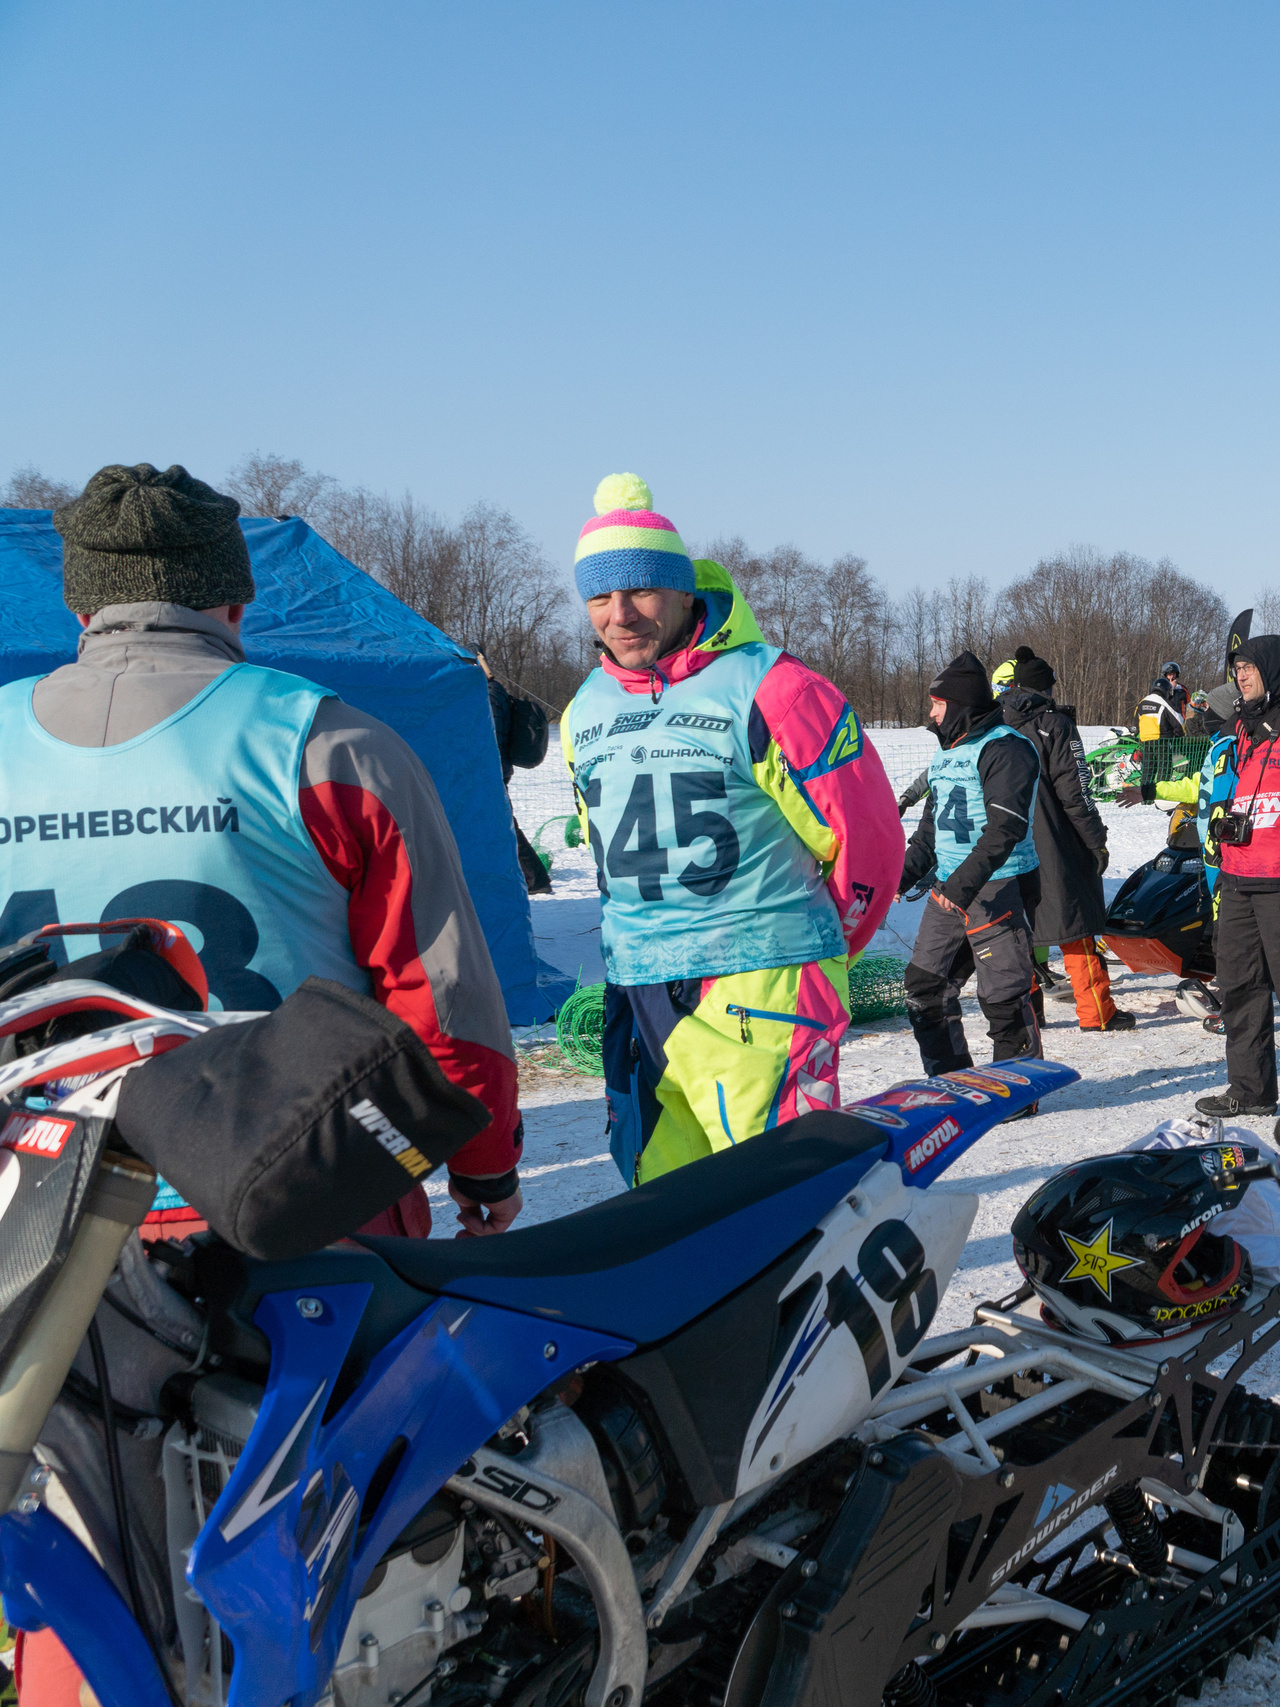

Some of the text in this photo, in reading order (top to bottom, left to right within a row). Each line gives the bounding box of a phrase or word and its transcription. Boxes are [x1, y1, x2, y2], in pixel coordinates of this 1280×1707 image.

[612, 712, 661, 728] SNOW
[0, 1116, 69, 1153] MOTUL
[909, 1120, 960, 1171] MOTUL
[1180, 1203, 1223, 1239] Airoh
[990, 1464, 1118, 1588] SNOWRIDER
